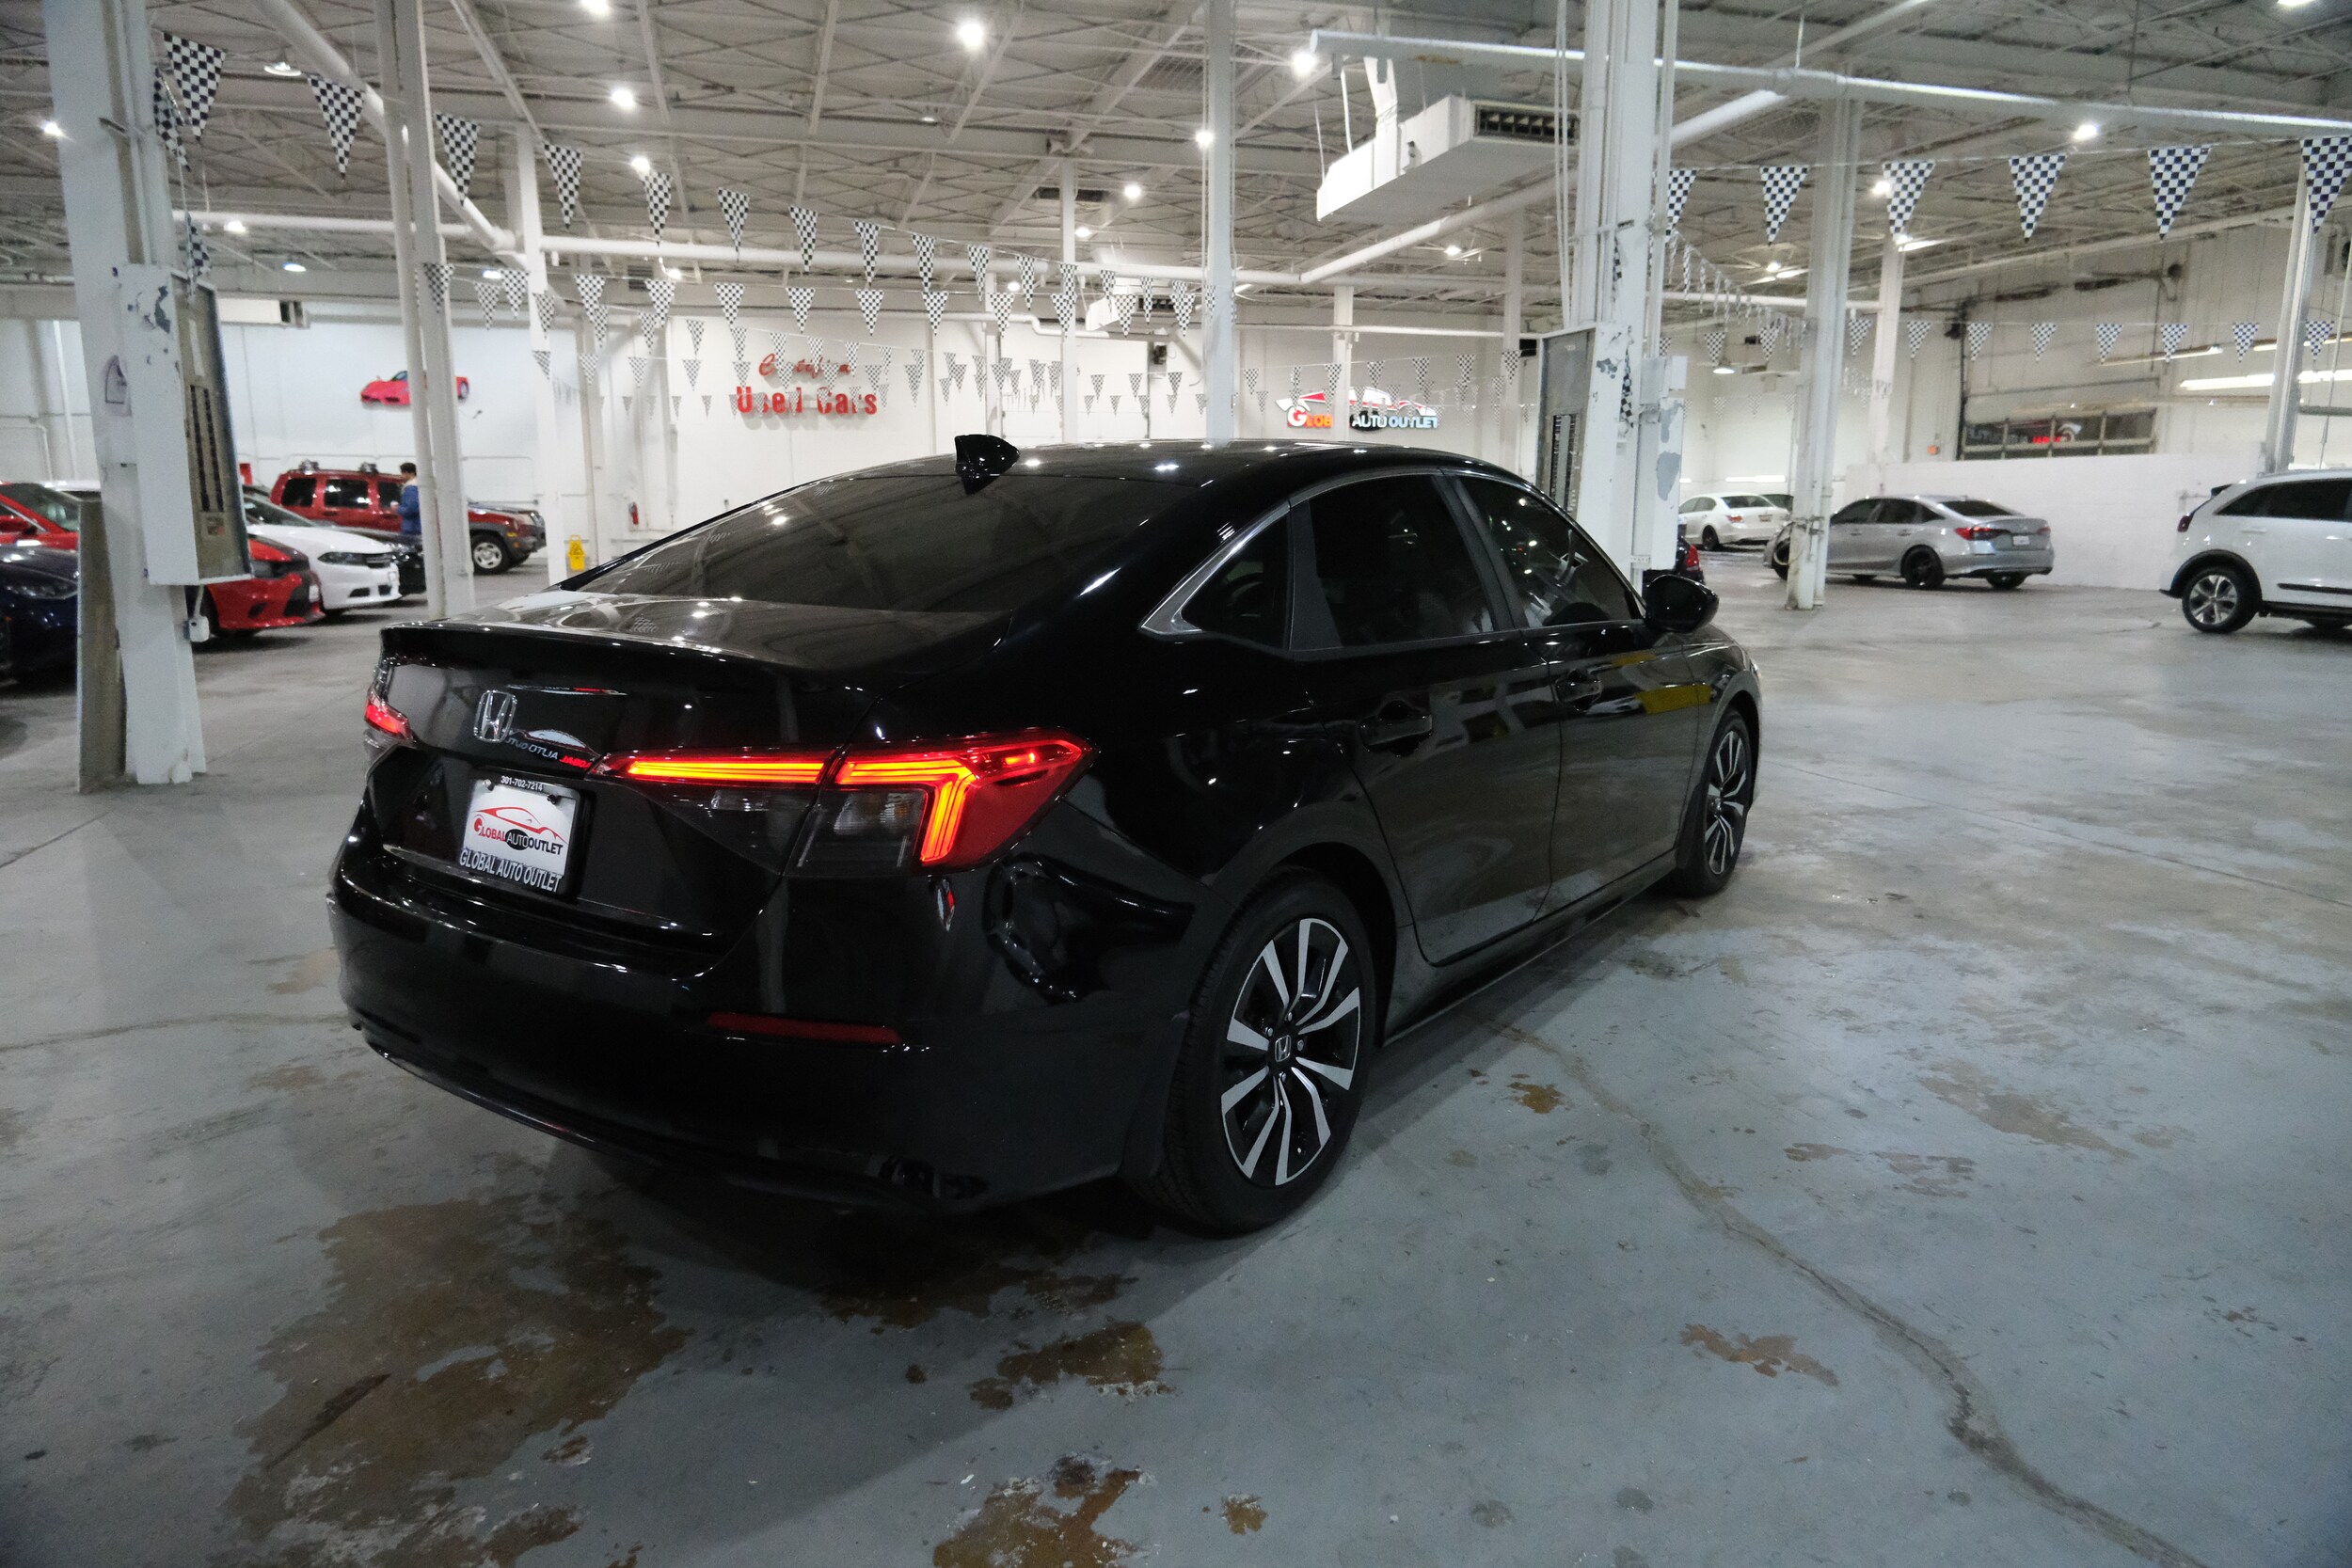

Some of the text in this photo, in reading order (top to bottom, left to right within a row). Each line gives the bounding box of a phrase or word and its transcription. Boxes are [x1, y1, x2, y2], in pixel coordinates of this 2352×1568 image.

[1287, 405, 1333, 428] GLOB
[1352, 414, 1388, 428] AUTO
[501, 775, 543, 791] 301-702-7214
[459, 848, 563, 893] GLOBAL AUTO OUTLET
